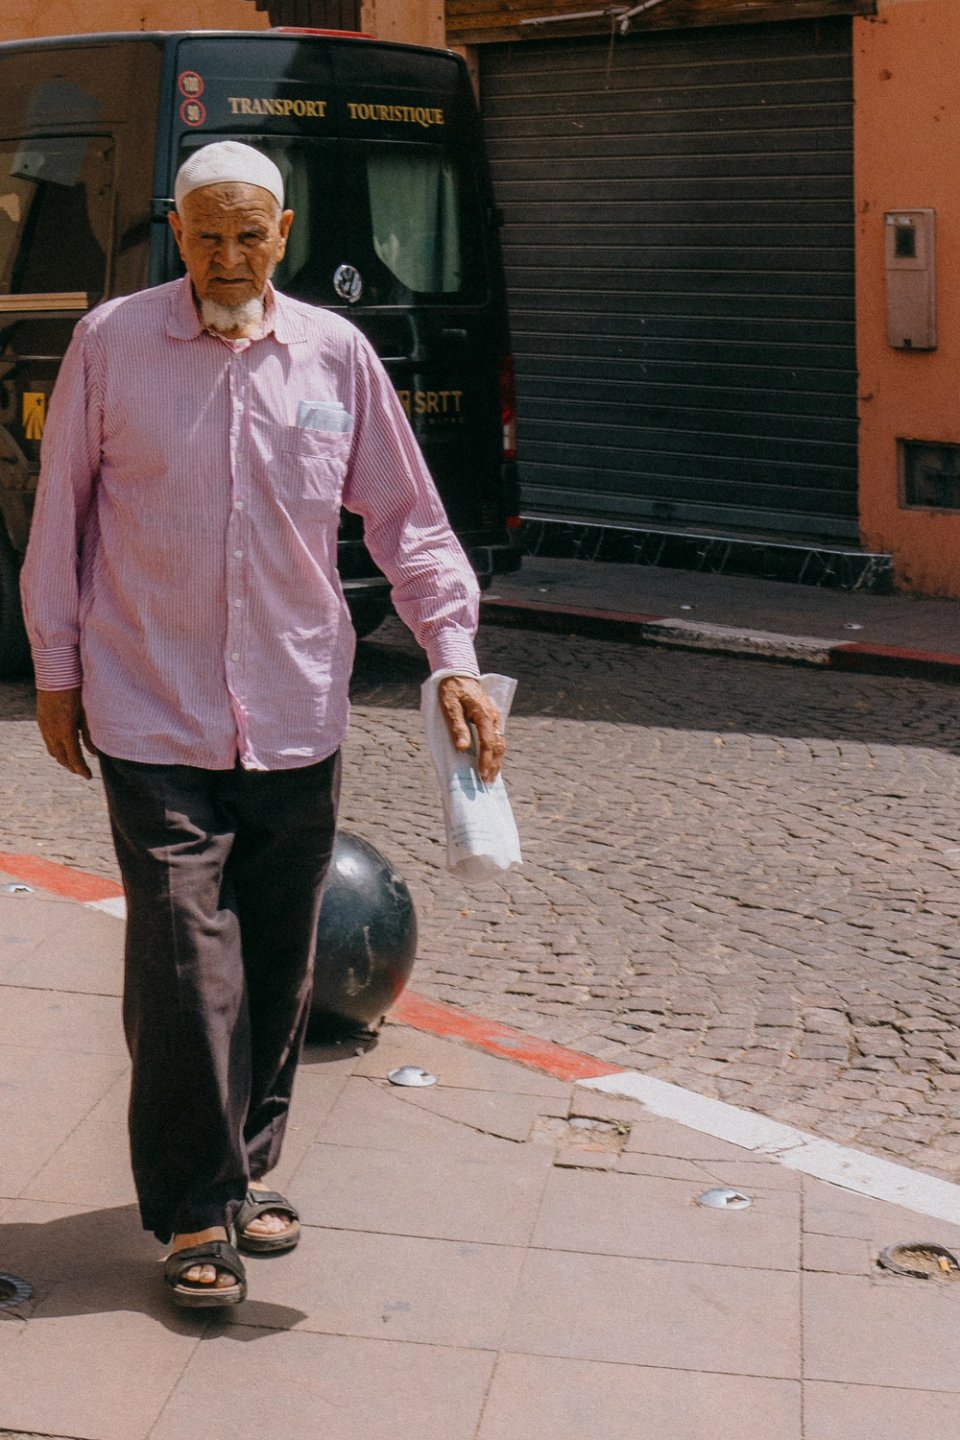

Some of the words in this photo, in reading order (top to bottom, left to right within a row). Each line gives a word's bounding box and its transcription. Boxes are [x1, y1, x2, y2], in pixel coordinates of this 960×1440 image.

[228, 97, 327, 118] TRANSPORT
[347, 102, 445, 128] TOURISTIQUE
[415, 391, 463, 414] SRTT
